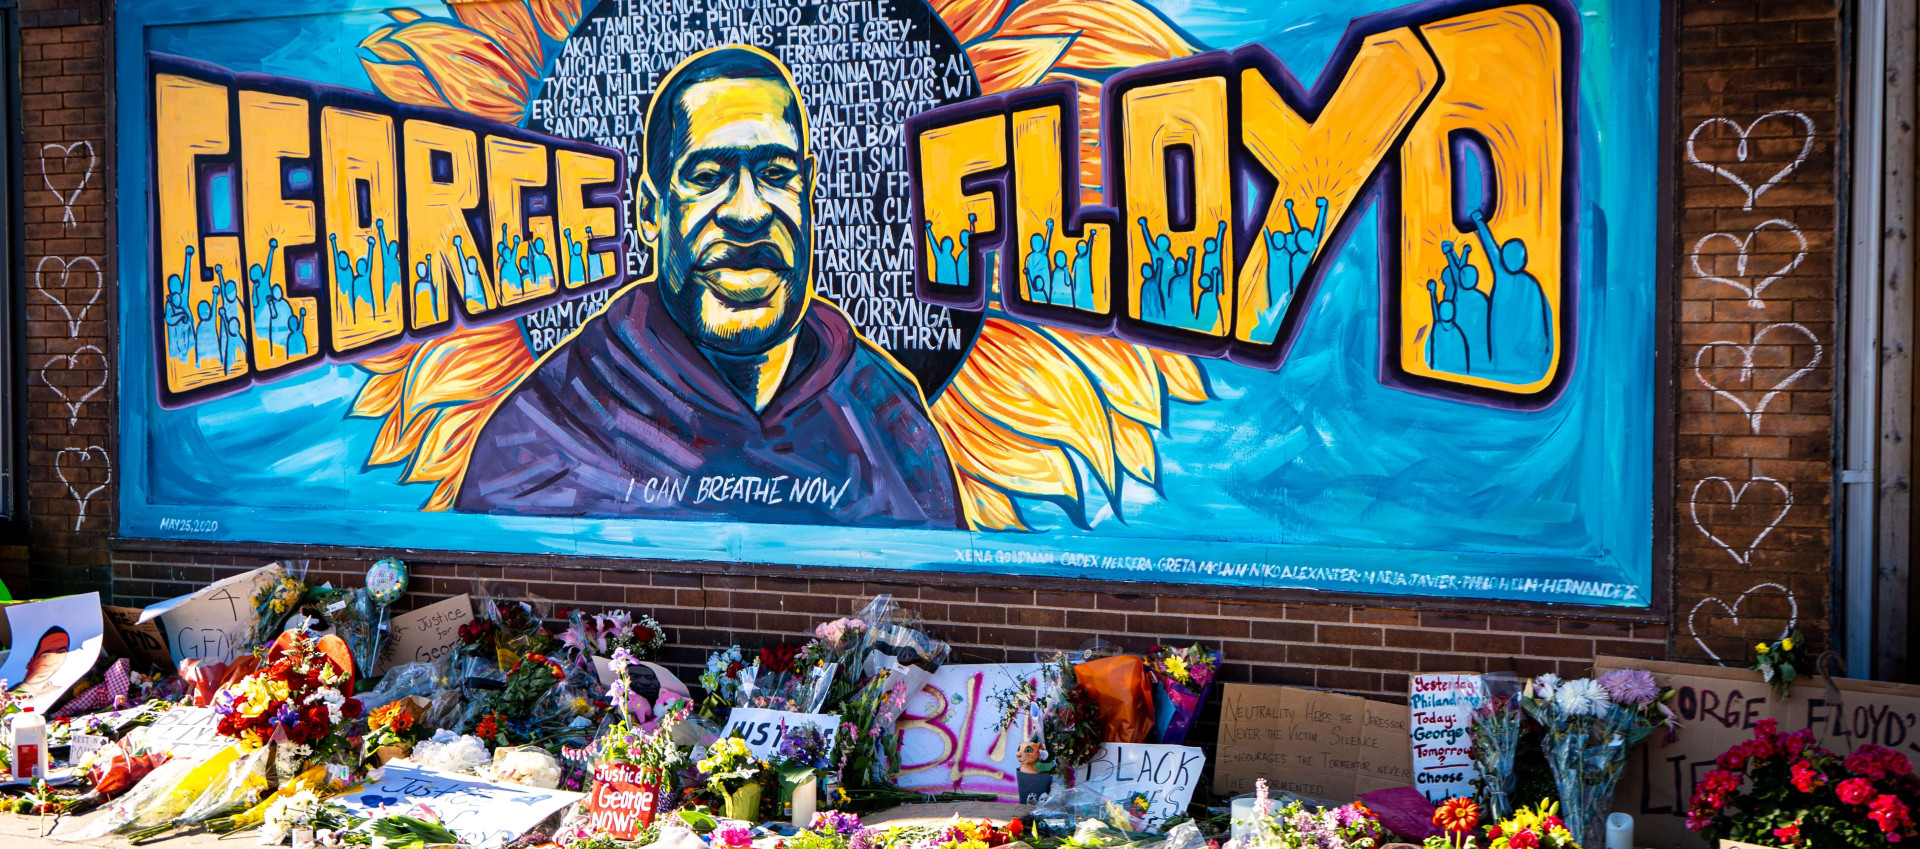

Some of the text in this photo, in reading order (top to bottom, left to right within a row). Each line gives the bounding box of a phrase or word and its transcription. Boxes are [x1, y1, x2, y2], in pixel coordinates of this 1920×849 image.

[592, 1, 890, 36] TAMIR RICE PHILANDO CASTILE
[563, 37, 598, 57] AKAI
[653, 31, 717, 53] KENDRA
[717, 25, 774, 48] JAMES
[786, 23, 860, 45] FREDDIE
[862, 18, 912, 42] GREY
[555, 54, 627, 77] MICHAEL
[775, 43, 850, 64] TERRANCE
[850, 40, 931, 60] FRANKLIN
[868, 56, 938, 82] TAYLOR
[942, 53, 970, 76] AL
[543, 72, 660, 100] TYISHA MILLE
[800, 76, 972, 107] SHANTEL DAVIS WI
[532, 96, 643, 120] ERIC GARNER
[805, 103, 880, 128] WALTER
[543, 113, 645, 138] SANDRA BLA
[809, 126, 859, 150] REKIA
[155, 3, 1564, 395] GEORGE FLOYD
[814, 172, 881, 199] SHELLY
[812, 198, 879, 227] JAMAR
[814, 223, 895, 250] TANISHA
[814, 249, 884, 273] TARIKA
[815, 271, 914, 299] ALTON STE
[838, 297, 953, 328] KORRYNGA
[865, 325, 961, 351] KATHRYN
[624, 473, 853, 510] I CAN BREATHE NOW
[955, 549, 993, 563] XENA
[1060, 551, 1101, 568] CADEX
[1101, 556, 1153, 572] HERRERA
[1157, 557, 1197, 573] GRETA
[416, 608, 467, 632] Justice
[435, 626, 452, 641] for
[725, 720, 834, 748] JUSTE
[1413, 712, 1457, 730] Today:
[1413, 727, 1464, 746] George
[1413, 744, 1476, 761] Tomorrow
[595, 764, 643, 785] Justice
[1085, 746, 1200, 787] BLACK
[1417, 772, 1464, 785] Choose
[598, 783, 654, 818] George
[591, 810, 636, 838] NOW!
